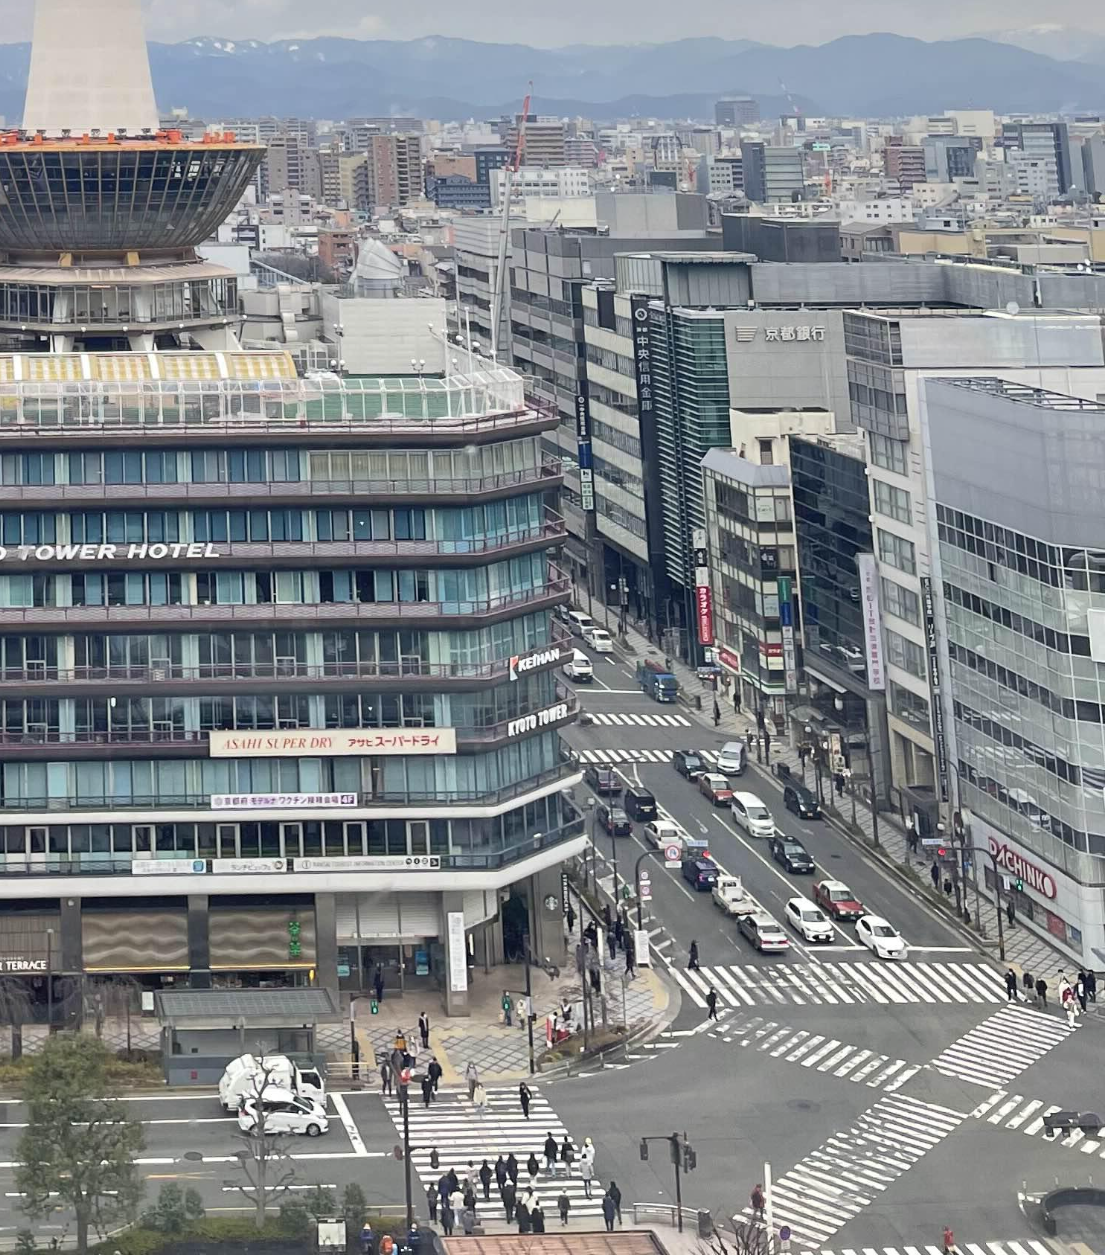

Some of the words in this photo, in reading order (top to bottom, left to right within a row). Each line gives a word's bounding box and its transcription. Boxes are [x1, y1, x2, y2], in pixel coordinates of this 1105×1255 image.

[765, 326, 826, 342] 京都銀行
[17, 544, 116, 561] TOWER
[127, 543, 220, 559] HOTEL
[518, 648, 560, 672] KEIHAN
[508, 715, 537, 737] KYOTO
[538, 704, 568, 726] TOWER
[222, 738, 263, 749] ASAHI
[265, 738, 307, 749] SUPER
[310, 737, 336, 748] DRY
[341, 795, 353, 804] 4F
[988, 836, 1057, 899] PACHINKO
[5, 960, 47, 970] TERRACE
